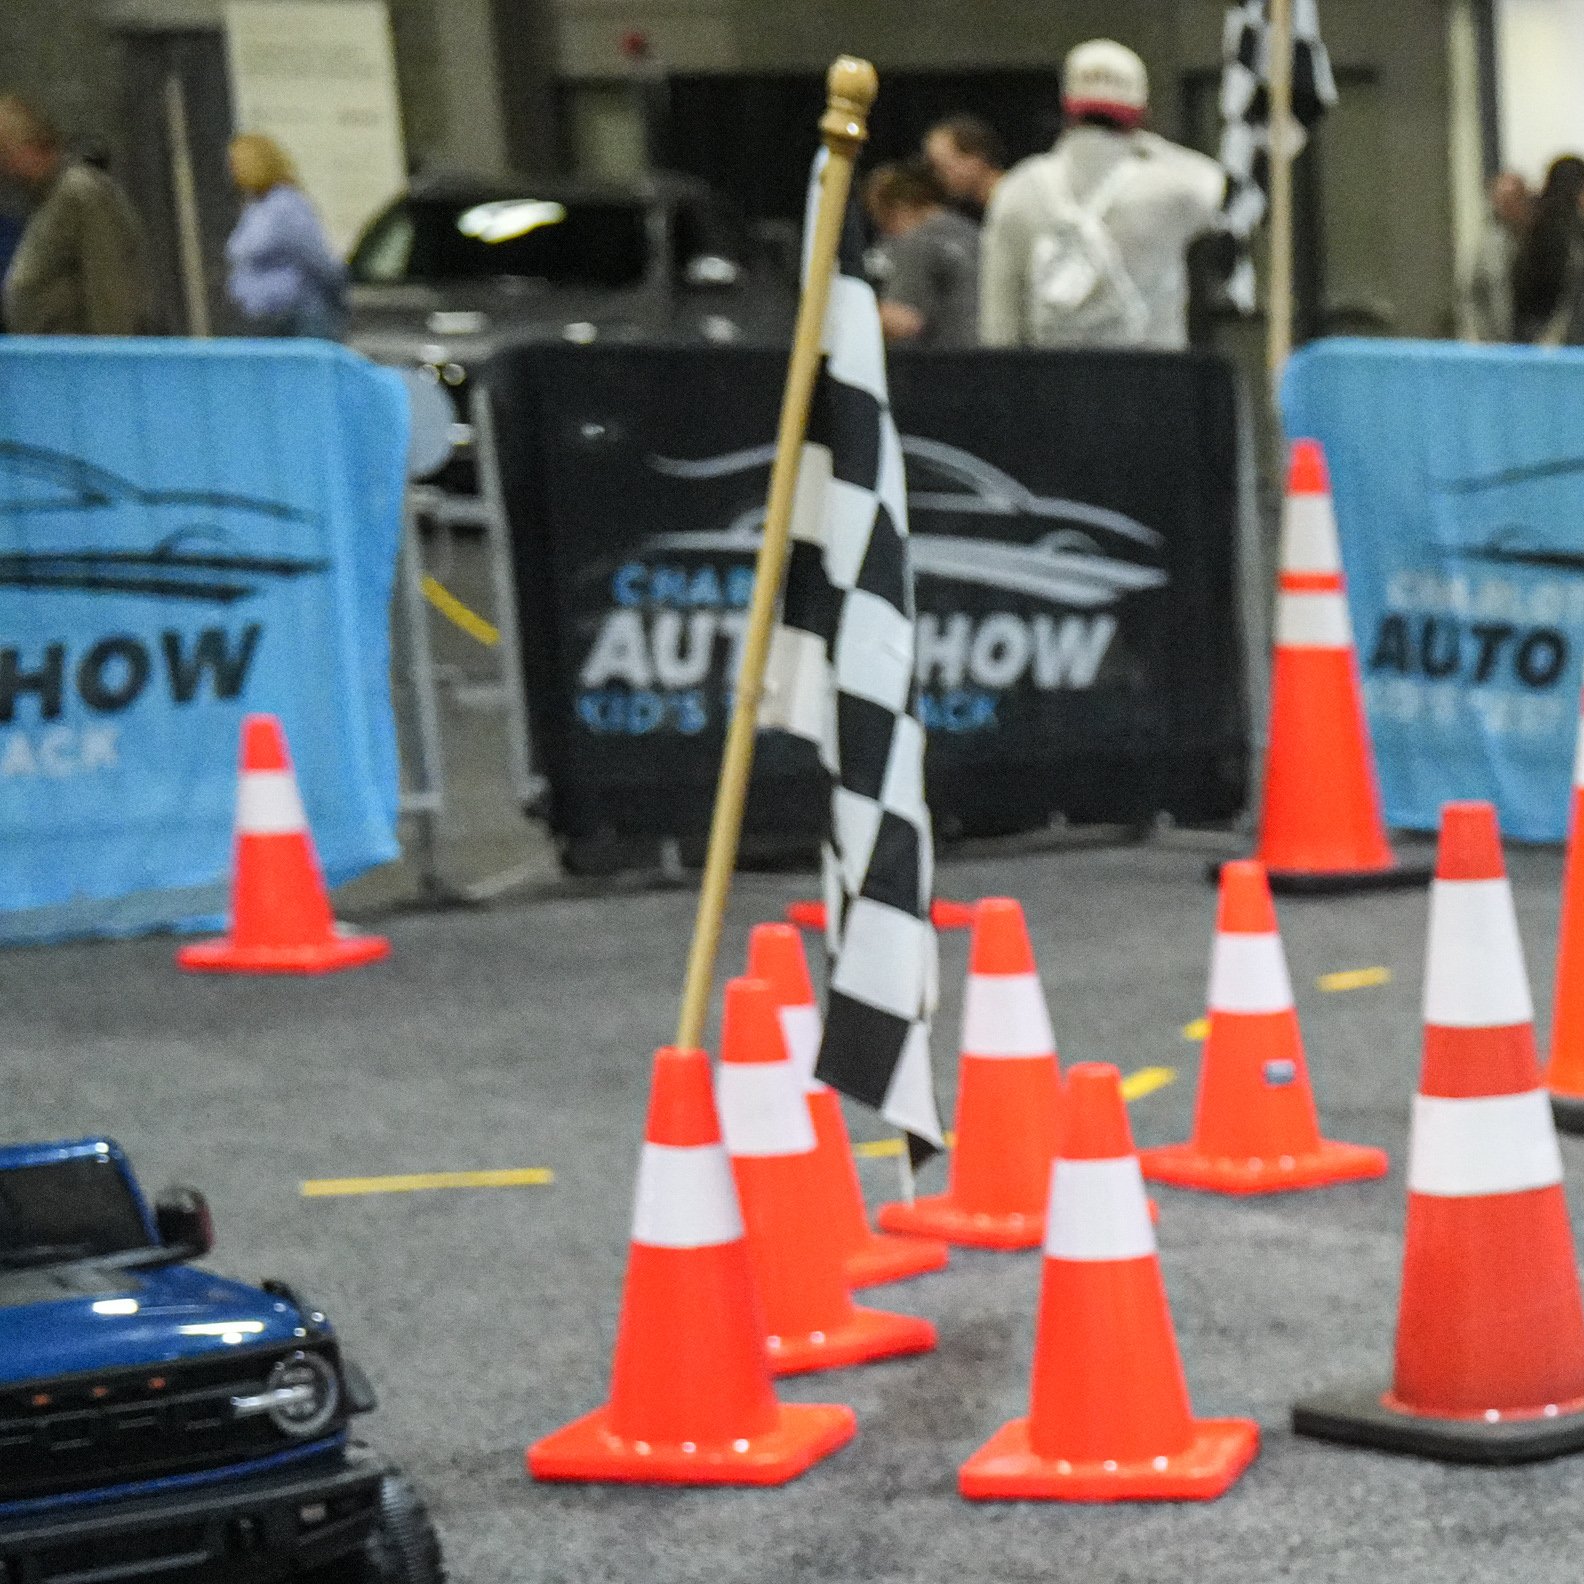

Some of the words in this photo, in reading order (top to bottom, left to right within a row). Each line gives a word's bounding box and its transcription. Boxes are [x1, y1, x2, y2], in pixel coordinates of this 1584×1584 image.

[0, 622, 262, 722] HOW
[580, 608, 756, 690] AUT
[915, 611, 1117, 690] HOW
[1369, 611, 1572, 692] AUTO
[2, 725, 121, 776] ACK
